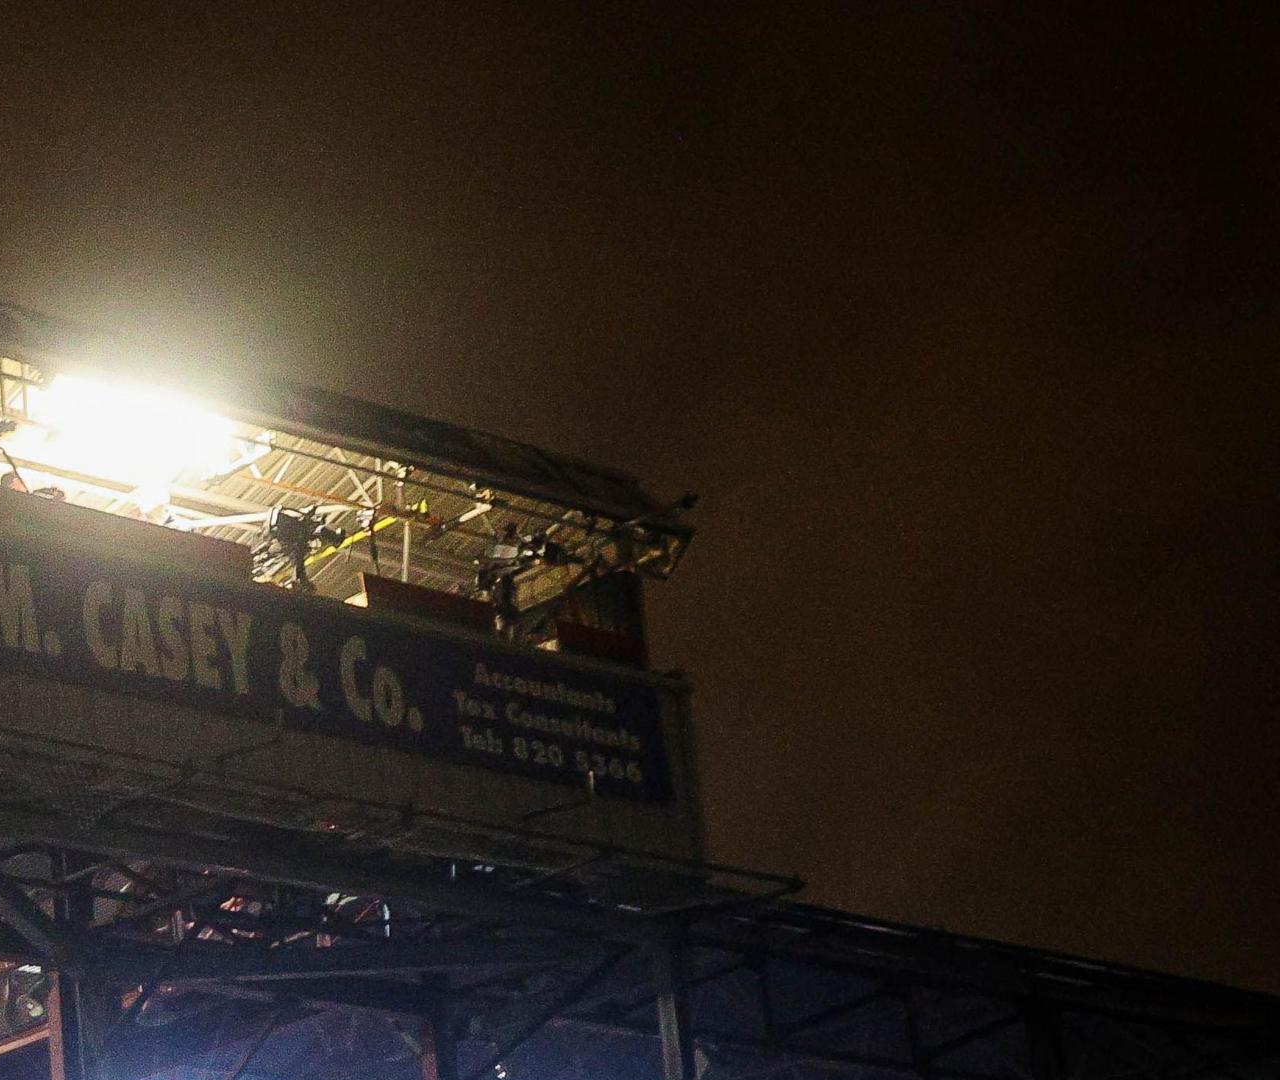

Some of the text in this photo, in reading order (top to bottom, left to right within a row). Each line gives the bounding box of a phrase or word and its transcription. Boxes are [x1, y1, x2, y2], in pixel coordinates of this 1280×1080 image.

[82, 580, 253, 695] CASEY
[278, 622, 322, 710] &
[472, 662, 617, 714] Accountants
[451, 689, 642, 751] Tax Consultants
[512, 736, 565, 768] 820
